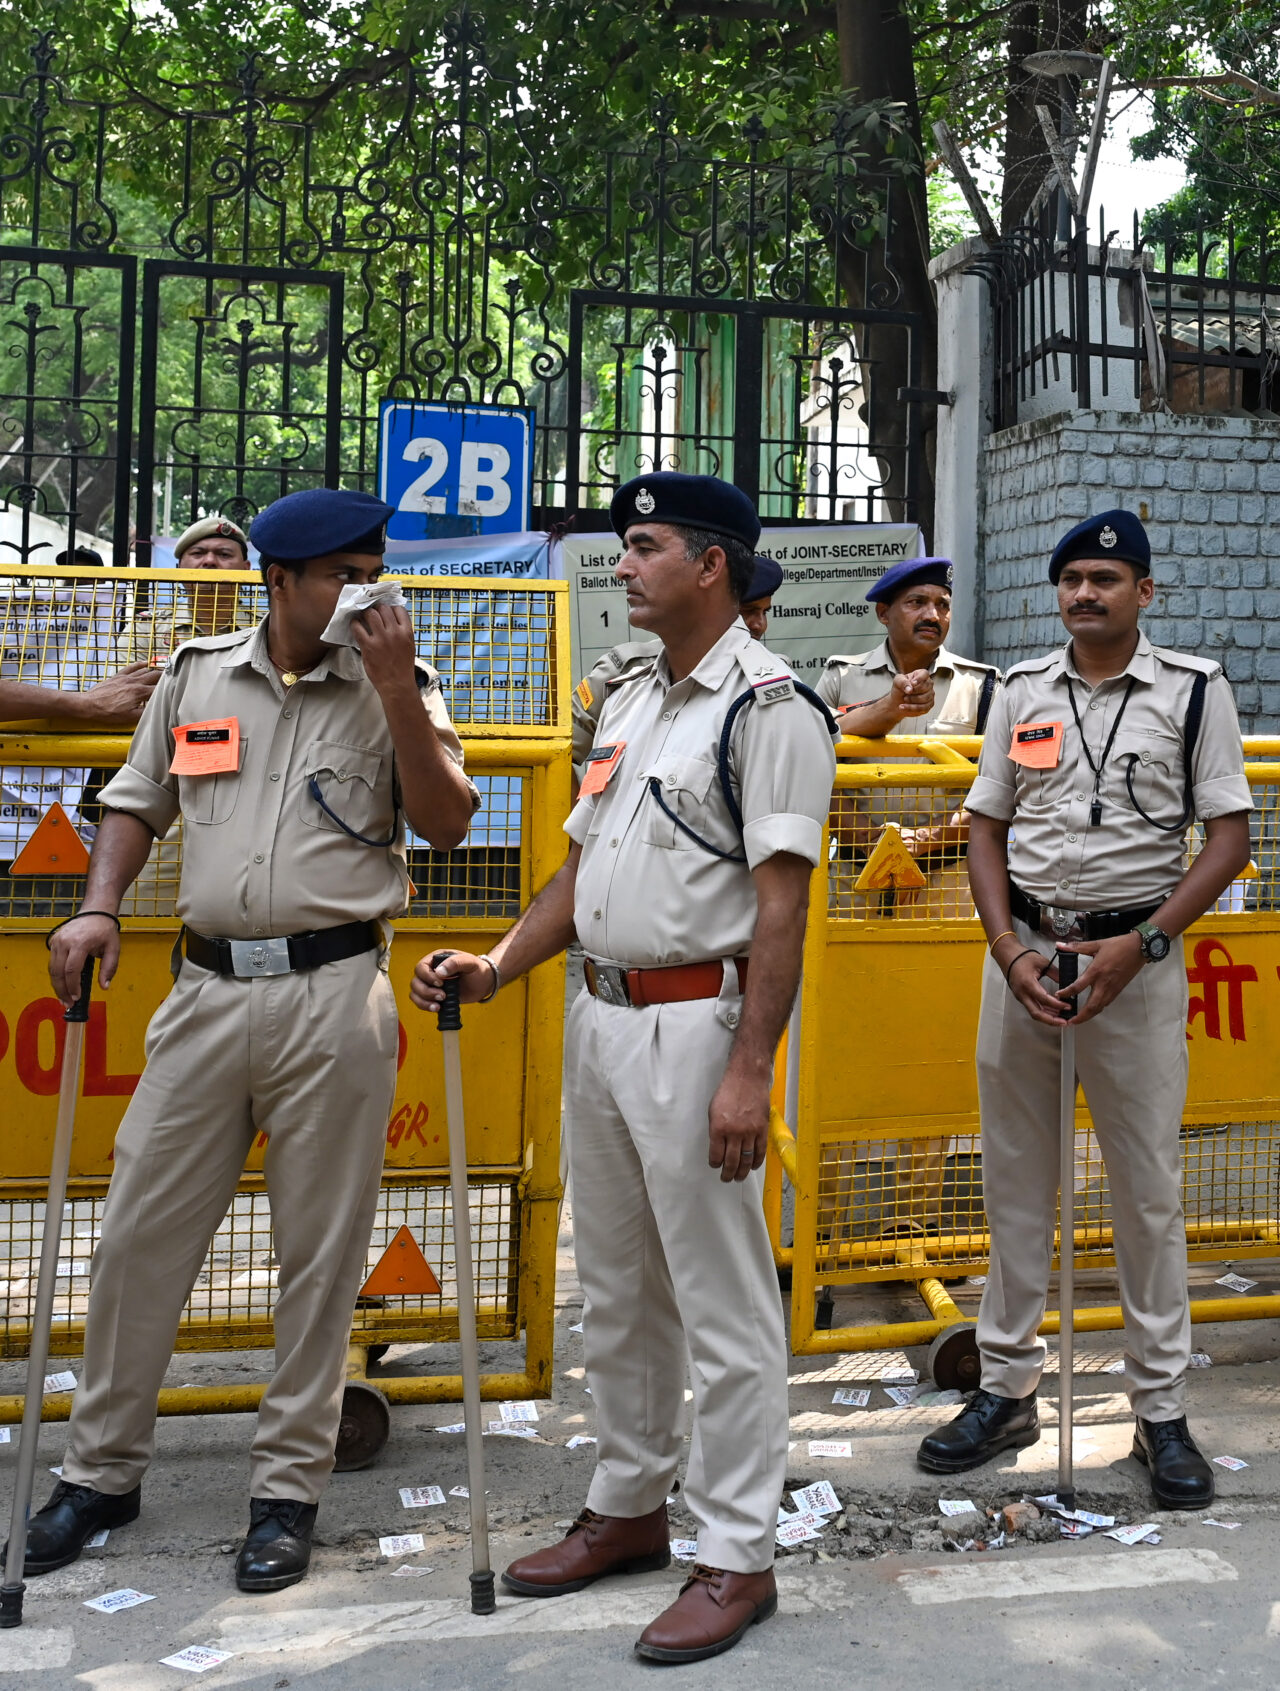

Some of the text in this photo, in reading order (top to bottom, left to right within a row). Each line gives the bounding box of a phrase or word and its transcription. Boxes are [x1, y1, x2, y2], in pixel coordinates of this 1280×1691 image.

[398, 437, 512, 517] 2B
[580, 543, 908, 567] List of ost of JOINT-SECRETARY
[420, 564, 436, 576] of
[440, 560, 533, 575] SECRETARY
[581, 566, 889, 588] Ballot No. llege/Department/Instit
[772, 602, 869, 619] Hansraj College
[600, 611, 609, 628] 1
[788, 659, 804, 670] tt.
[806, 658, 817, 669] of
[0, 803, 38, 817] ehru
[811, 1486, 828, 1507] YASH
